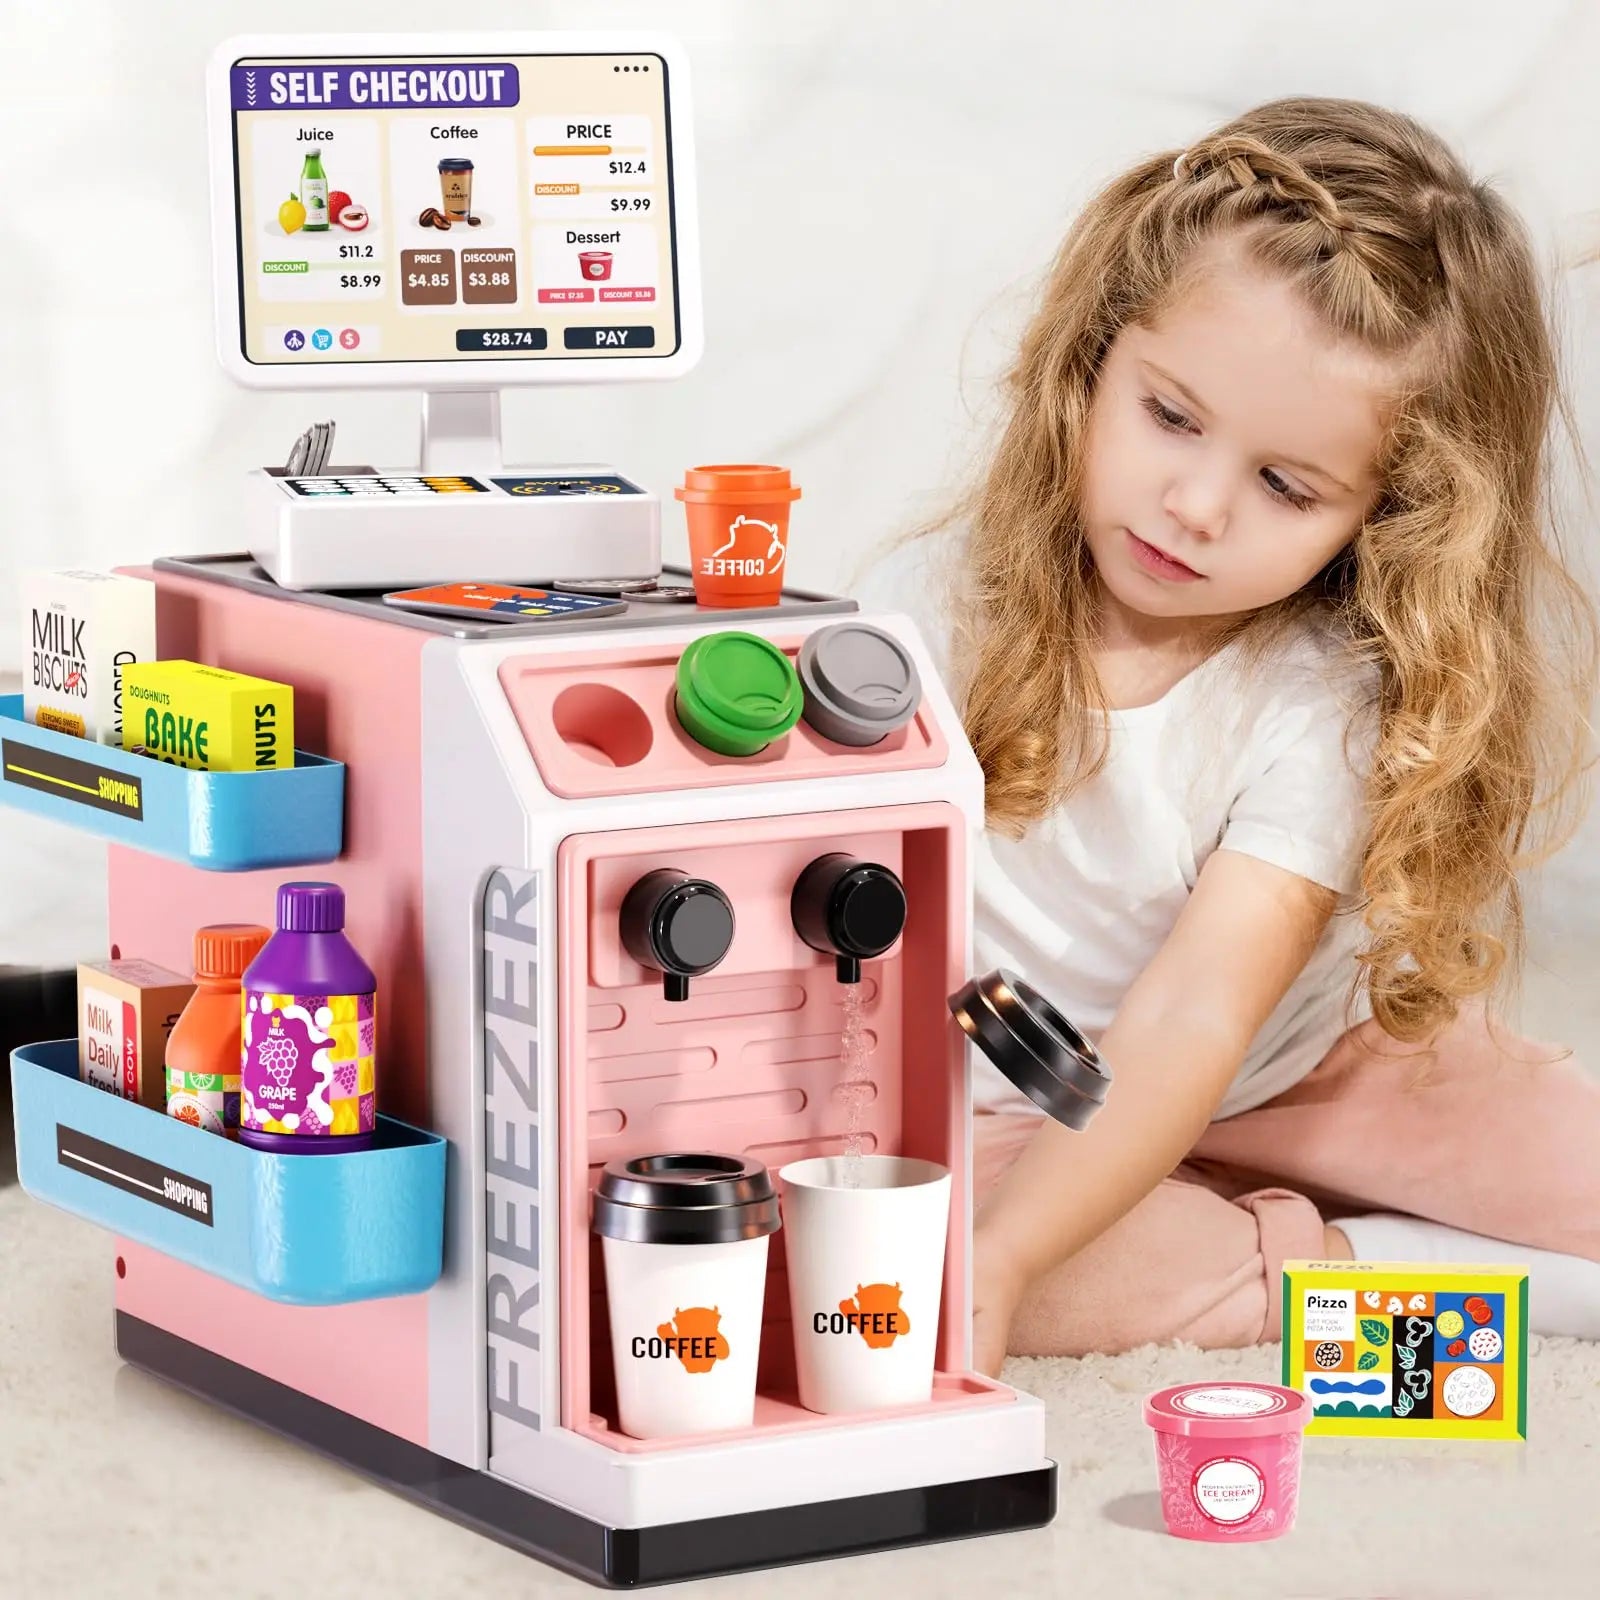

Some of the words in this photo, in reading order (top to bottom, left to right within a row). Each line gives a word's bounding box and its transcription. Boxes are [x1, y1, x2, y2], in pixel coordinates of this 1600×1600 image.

[270, 72, 339, 104] SELF
[349, 70, 505, 103] CHECKOUT
[296, 128, 334, 141] Juice
[430, 126, 478, 139] Coffee
[566, 124, 612, 138] PRICE
[609, 161, 646, 174] $12.4
[536, 186, 578, 194] DISCOUNT
[610, 198, 651, 212] $9.99
[566, 231, 621, 244] Dessert
[339, 245, 374, 259] $11.2
[414, 254, 442, 264] PRICE
[463, 253, 514, 263] DISCOUNT
[264, 263, 306, 272] DISCOUNT
[340, 275, 381, 288] $8.99
[408, 273, 449, 288] $4.85
[469, 272, 510, 287] $3.88
[482, 331, 533, 346] $28.74
[595, 330, 628, 345] PAY
[32, 608, 86, 660] MILK
[33, 651, 87, 699] BISCUITS
[129, 685, 170, 705] DOUGHNUTS
[145, 707, 208, 763] BAKE
[255, 703, 276, 771] NUTS
[98, 776, 139, 808] SHOPPING
[87, 1003, 113, 1037] Milk
[268, 1027, 285, 1036] MILK
[88, 1037, 119, 1077] Daily
[259, 1085, 297, 1100] GRAPE
[484, 866, 541, 1433] FREEZER
[163, 1176, 208, 1214] SHOPPING
[1307, 1295, 1347, 1309] Pizza
[812, 1312, 899, 1334] COFFEE
[631, 1336, 717, 1359] COFFEE
[1222, 1488, 1255, 1497] CREAM
